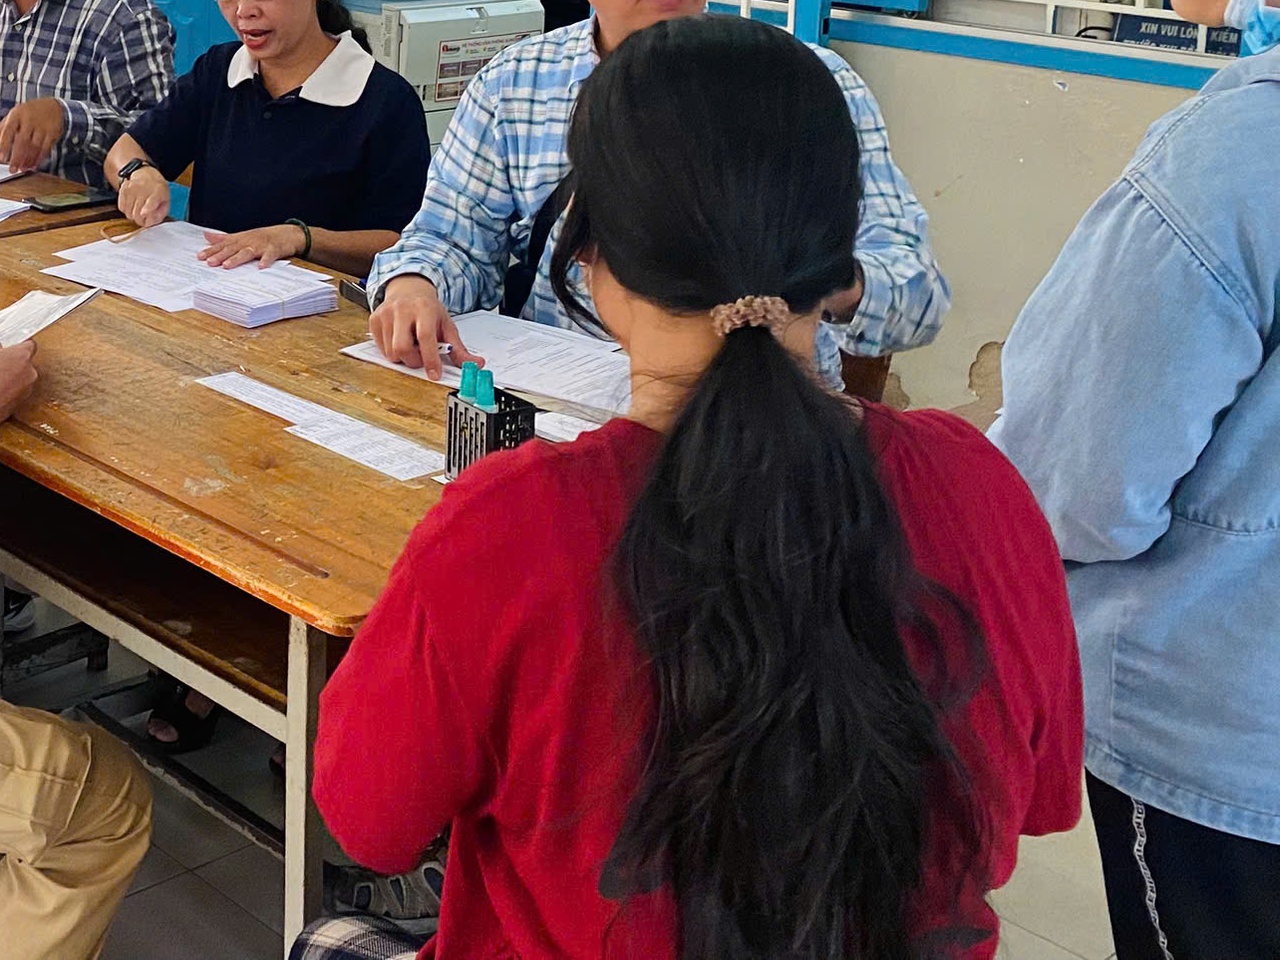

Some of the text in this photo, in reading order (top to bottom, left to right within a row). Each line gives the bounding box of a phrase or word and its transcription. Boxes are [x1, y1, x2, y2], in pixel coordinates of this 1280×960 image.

[1140, 22, 1158, 35] XIN
[1160, 25, 1178, 37] VUI
[1180, 25, 1199, 39] LÒN
